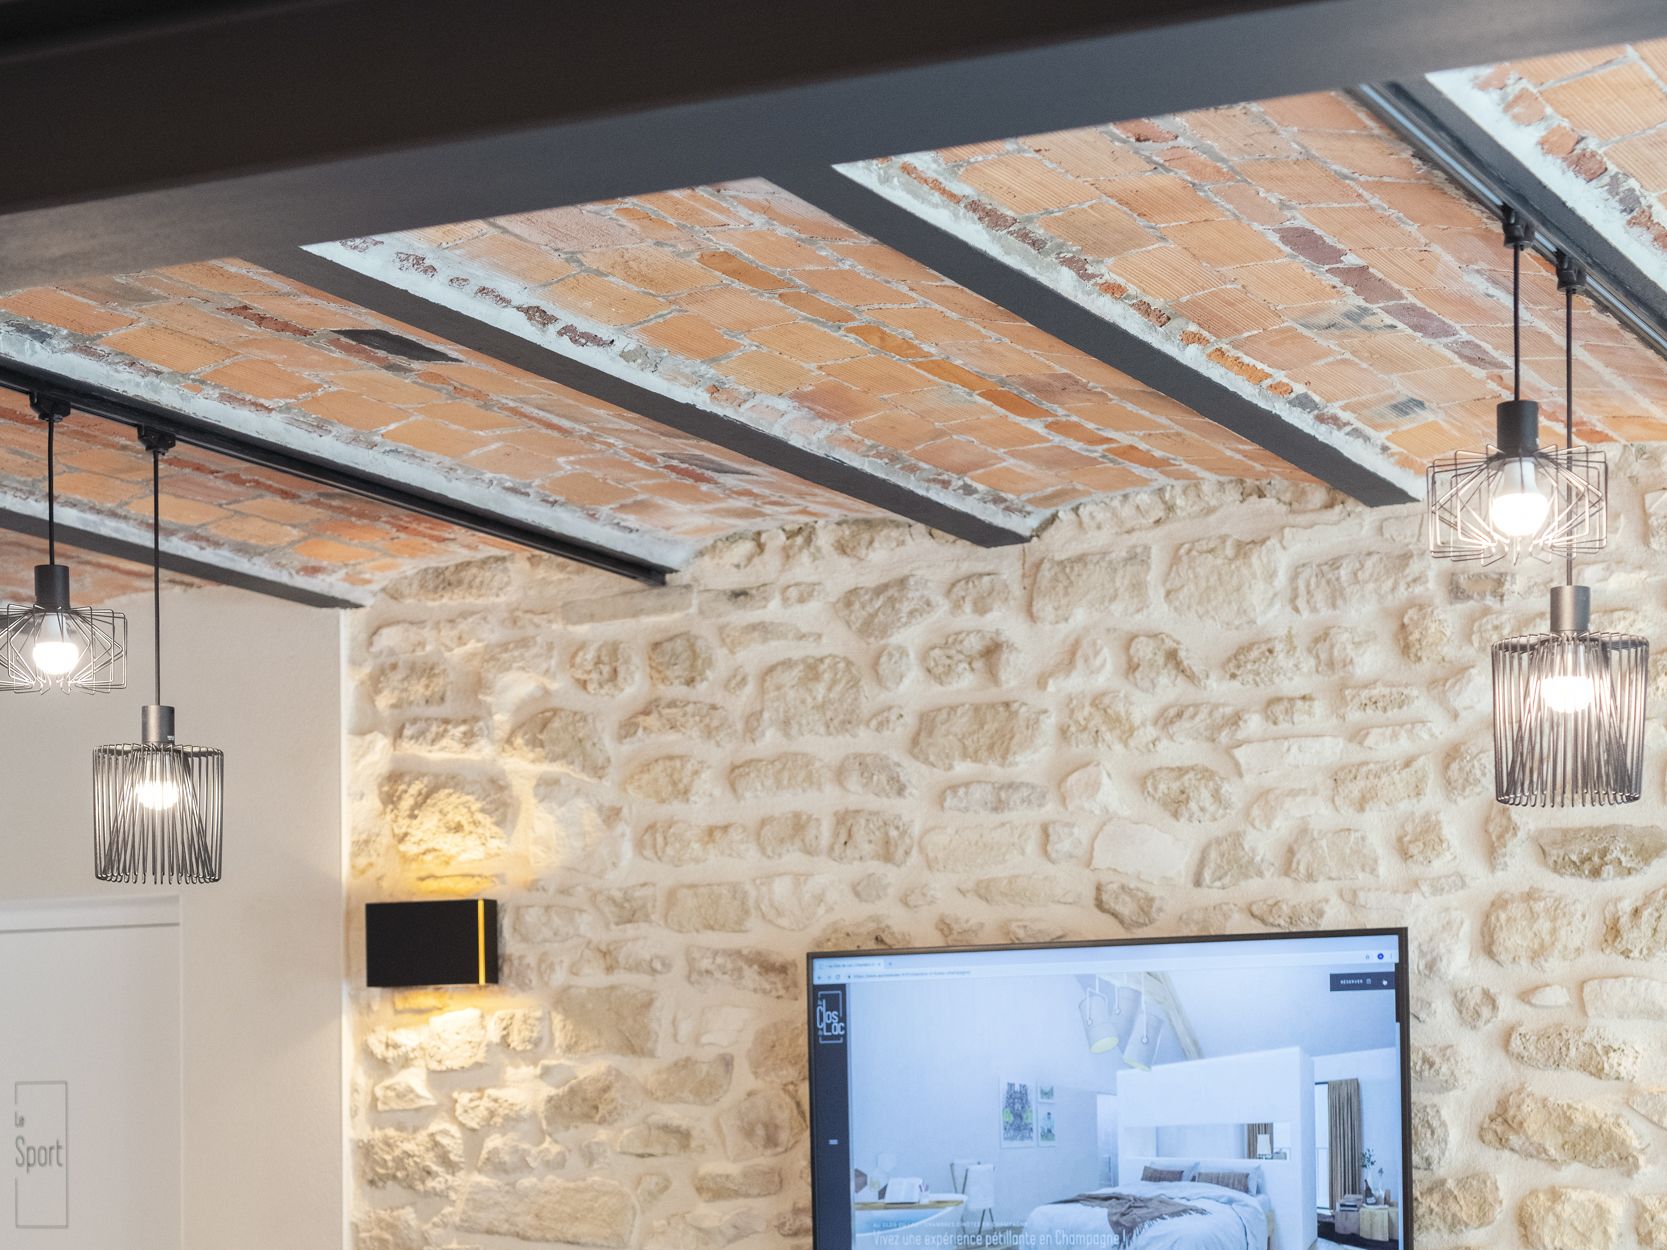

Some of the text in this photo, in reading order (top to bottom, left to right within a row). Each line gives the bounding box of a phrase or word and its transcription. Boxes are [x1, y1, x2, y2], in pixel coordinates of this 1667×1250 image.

[14, 1135, 63, 1175] Sport
[874, 1227, 899, 1246] Vivez
[903, 1233, 921, 1246] une
[924, 1231, 983, 1248] expérience
[985, 1230, 1036, 1248] pétillante
[1039, 1232, 1053, 1245] en
[1054, 1229, 1119, 1248] Champagne
